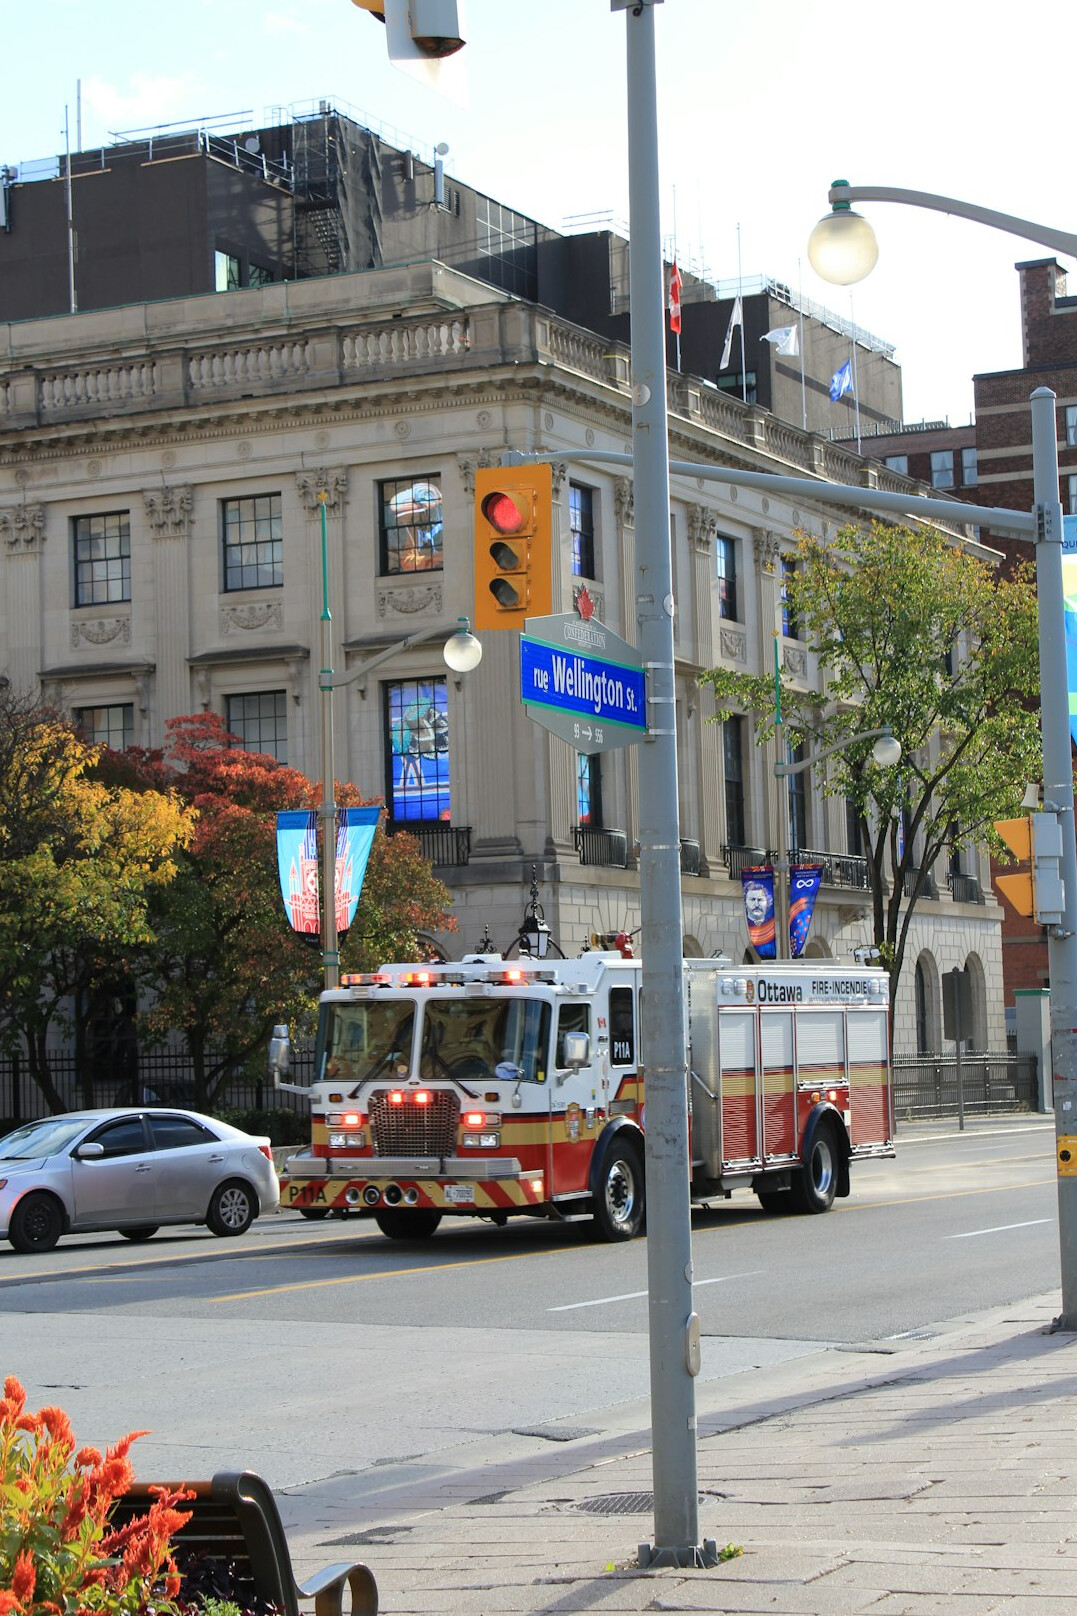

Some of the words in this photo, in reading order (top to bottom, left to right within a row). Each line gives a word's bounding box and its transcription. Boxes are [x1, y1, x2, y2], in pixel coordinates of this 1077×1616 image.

[1061, 540, 1077, 549] QU
[533, 667, 549, 690] rue
[552, 654, 623, 713] Wellington
[758, 980, 803, 1002] Ottawa
[613, 1041, 631, 1059] P11A
[289, 1186, 327, 1203] P11A
